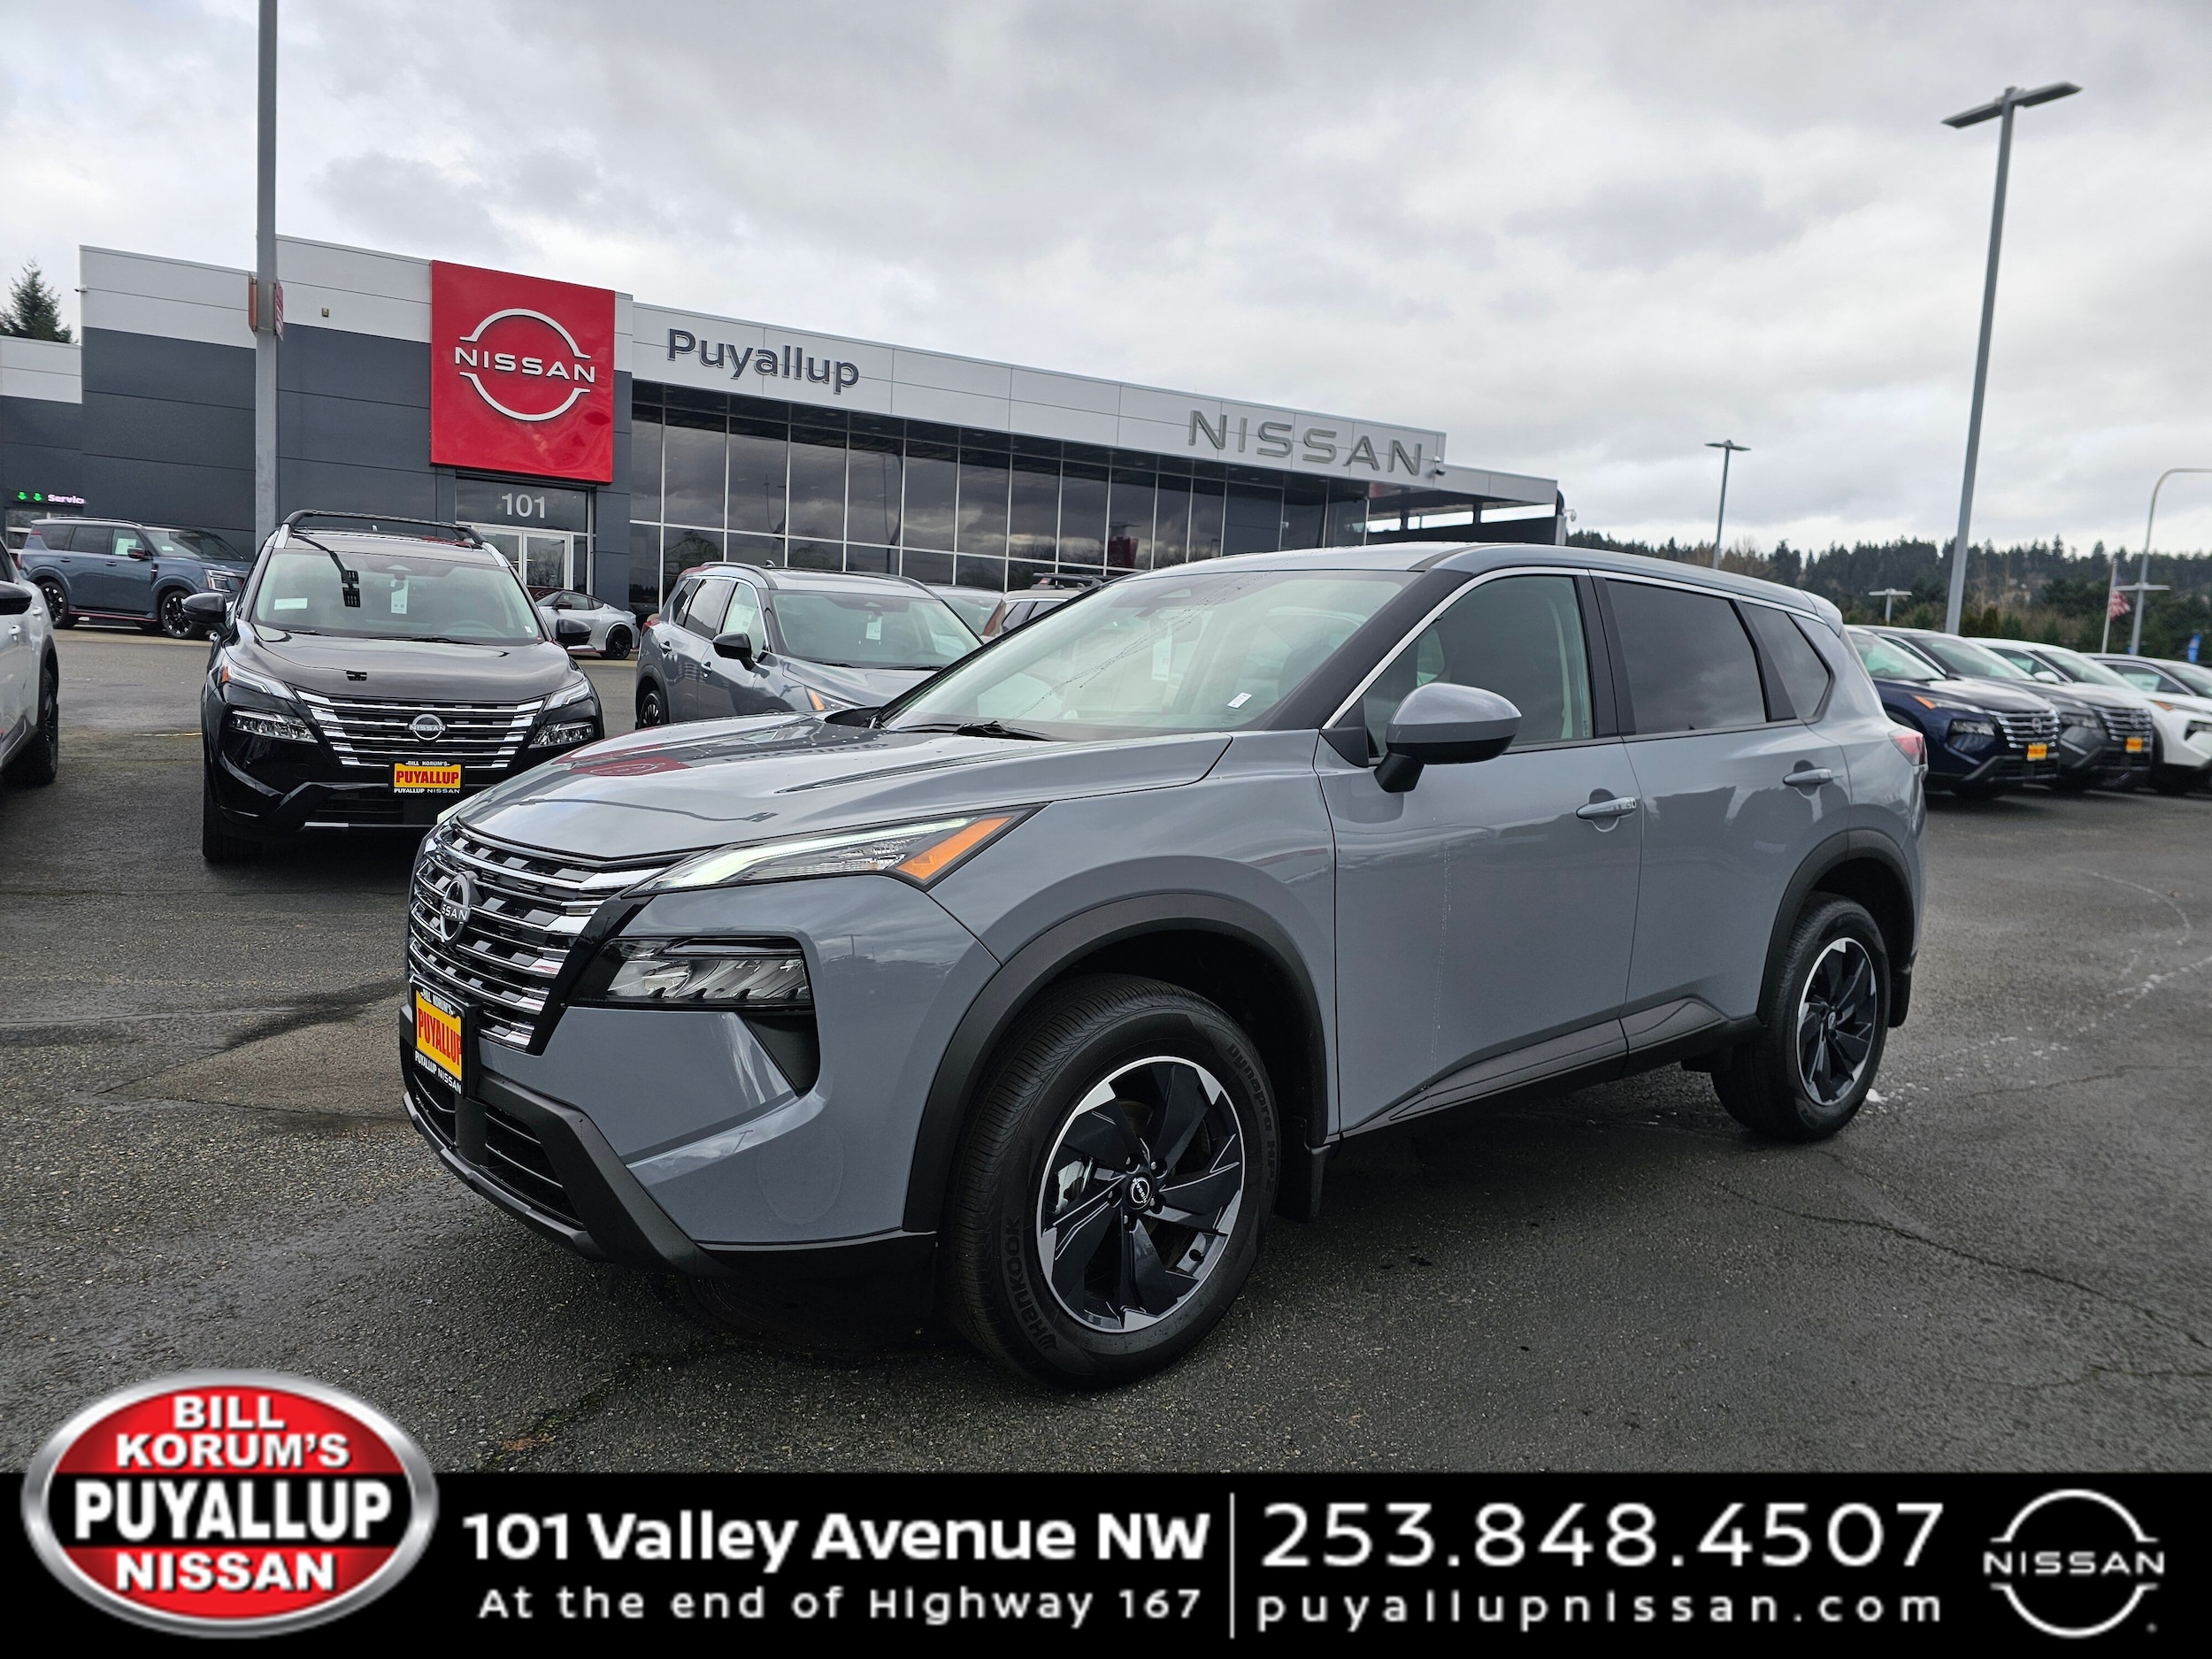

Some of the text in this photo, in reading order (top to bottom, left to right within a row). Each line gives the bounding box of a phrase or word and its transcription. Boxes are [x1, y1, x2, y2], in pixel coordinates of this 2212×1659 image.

[455, 347, 595, 383] NISSAN
[667, 328, 859, 395] Puyallup
[1188, 410, 1422, 475] NISSAN
[501, 493, 546, 518] 101
[396, 771, 459, 785] PUYALLUP
[418, 1007, 462, 1066] PUYALLUP
[414, 1050, 462, 1094] PUYALLUP NISSAN
